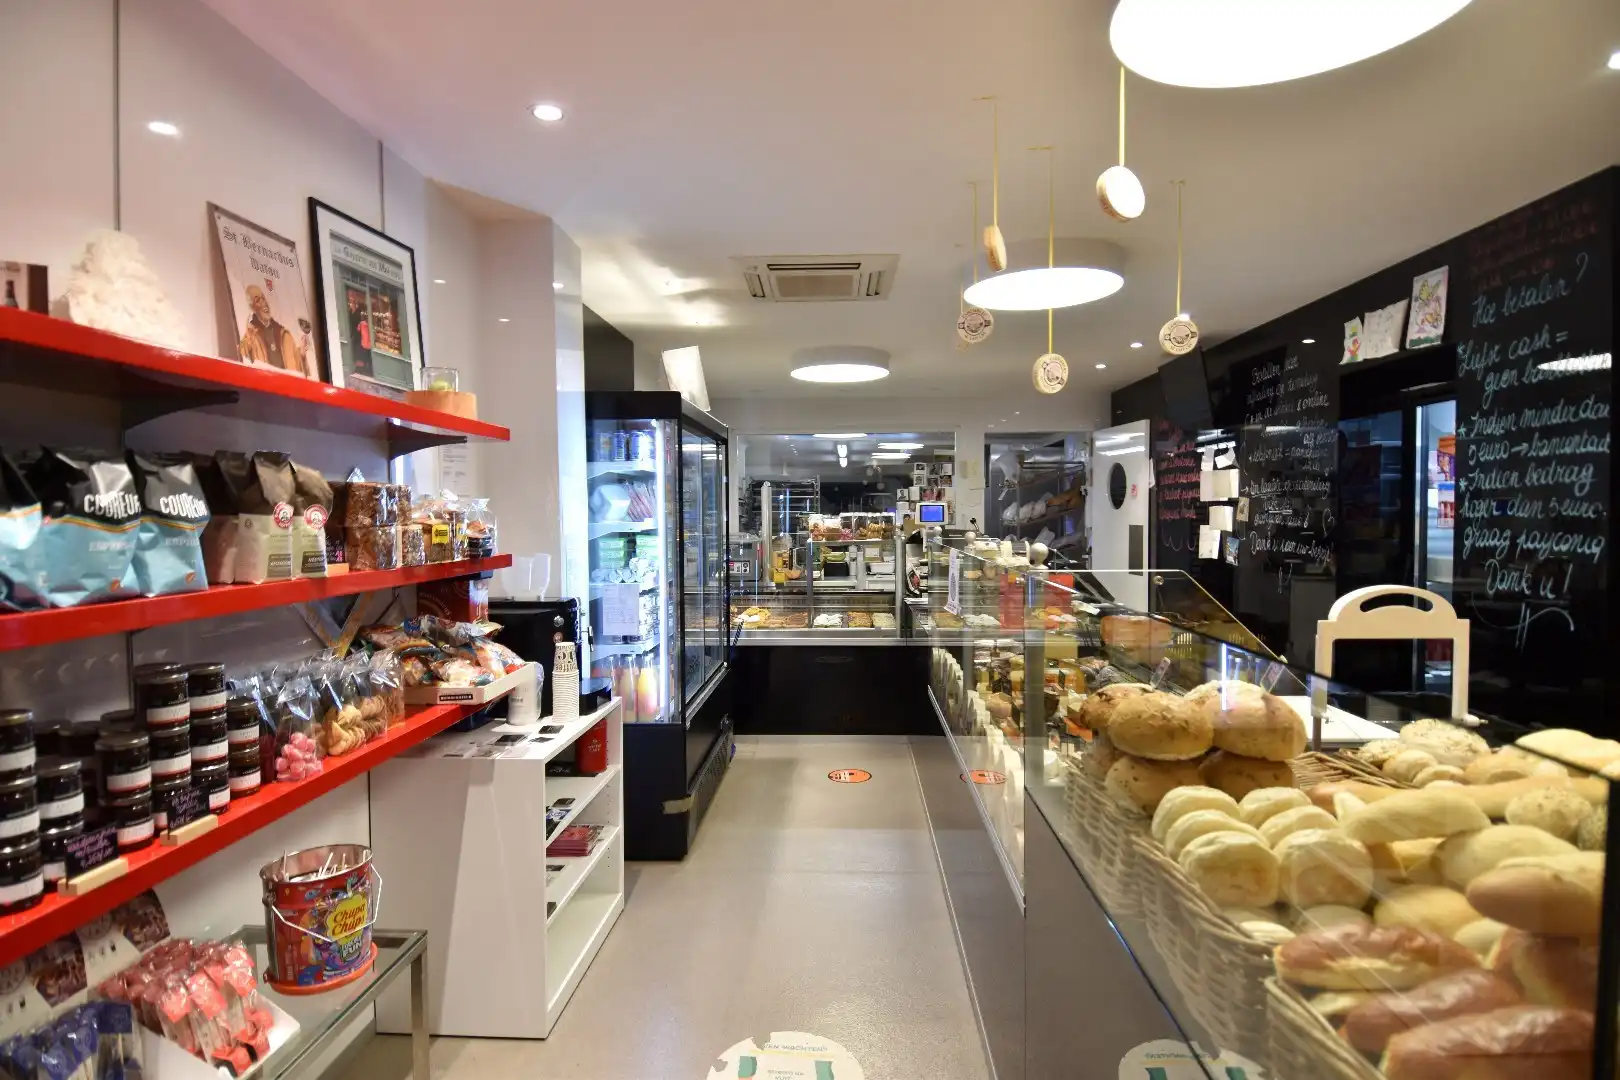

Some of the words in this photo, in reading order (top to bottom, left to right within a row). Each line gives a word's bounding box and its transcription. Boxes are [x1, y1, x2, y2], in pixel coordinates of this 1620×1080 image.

[1472, 295, 1496, 328] Hoe
[1502, 273, 1571, 316] betalen
[1509, 324, 1552, 359] cash
[1482, 368, 1519, 409] geen
[1470, 410, 1517, 438] Indien
[1520, 398, 1577, 428] minder
[1478, 440, 1510, 461] euro
[1468, 467, 1523, 491] Indien
[1525, 460, 1598, 497] bedrag
[1460, 491, 1502, 531] hoger
[1507, 492, 1545, 519] dan
[1462, 526, 1512, 560] graag
[1515, 528, 1606, 564] payconiq
[1485, 558, 1532, 595] Dank
[333, 903, 366, 922] Chupa
